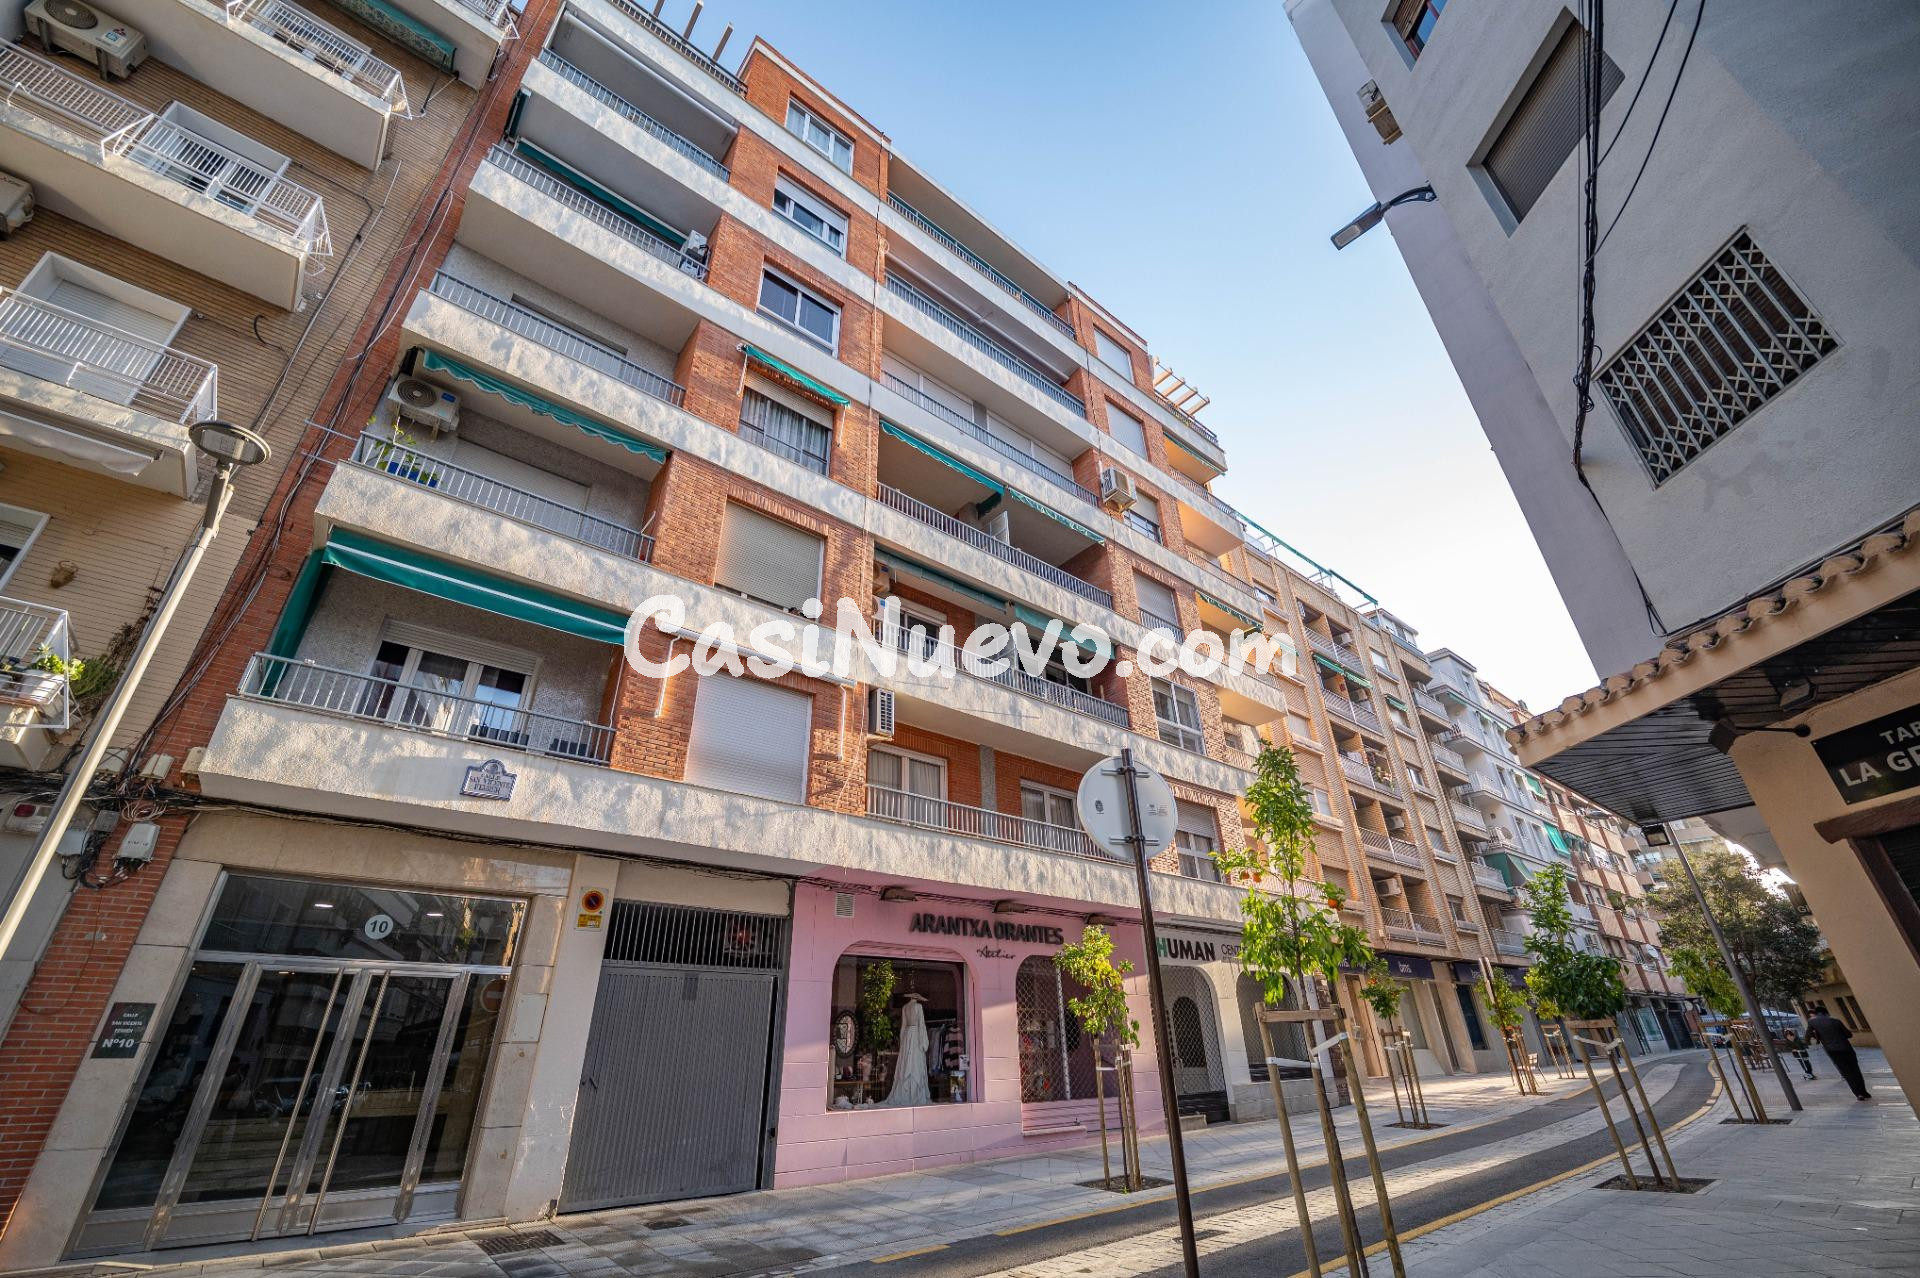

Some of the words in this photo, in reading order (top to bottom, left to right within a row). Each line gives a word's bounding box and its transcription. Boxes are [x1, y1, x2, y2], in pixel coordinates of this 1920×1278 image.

[1839, 761, 1882, 787] LA
[370, 919, 389, 934] 10
[910, 912, 993, 939] ARANTXA
[993, 921, 1065, 945] ORANTES
[976, 945, 1016, 960] Atelier
[1156, 936, 1216, 962] HUMAN
